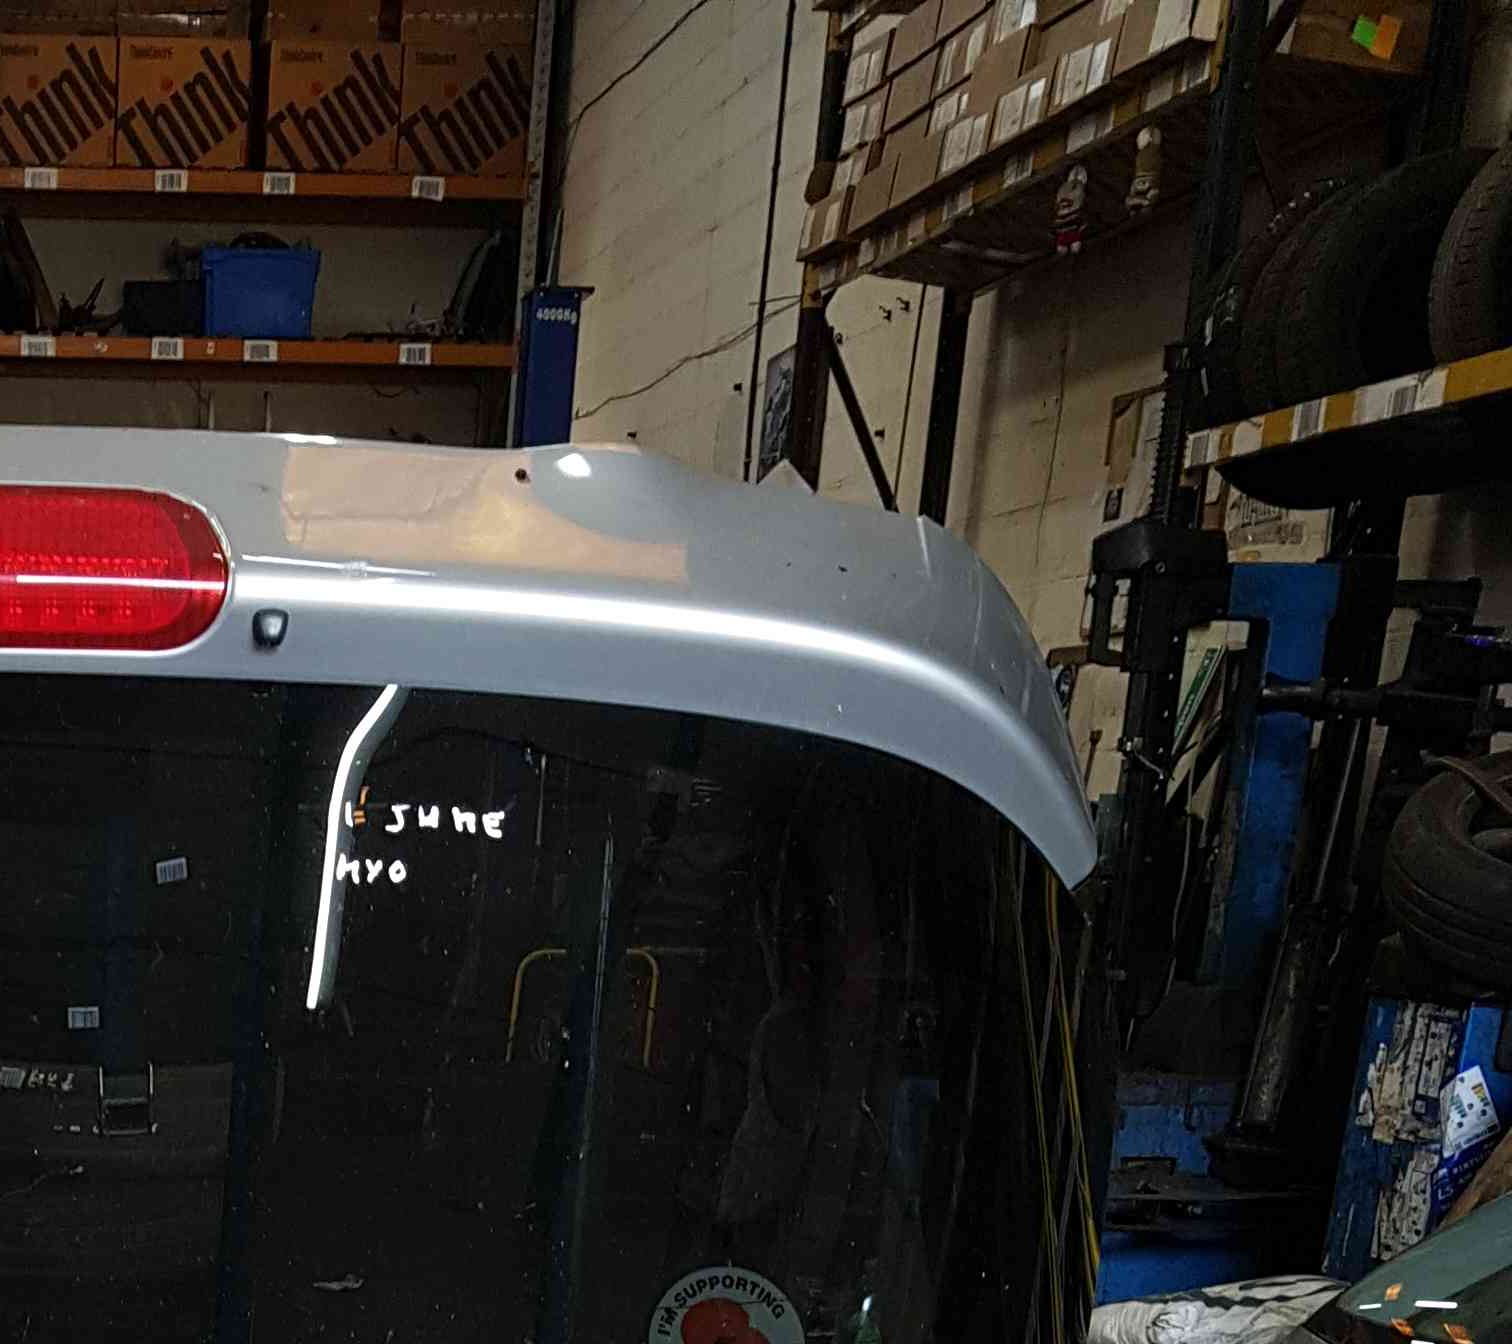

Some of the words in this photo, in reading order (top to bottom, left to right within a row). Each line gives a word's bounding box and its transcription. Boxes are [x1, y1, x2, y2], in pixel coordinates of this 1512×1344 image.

[119, 47, 249, 168] Think
[265, 50, 400, 171] Think
[657, 1307, 678, 1337] I'M
[673, 1275, 785, 1321] SUPPORTING
